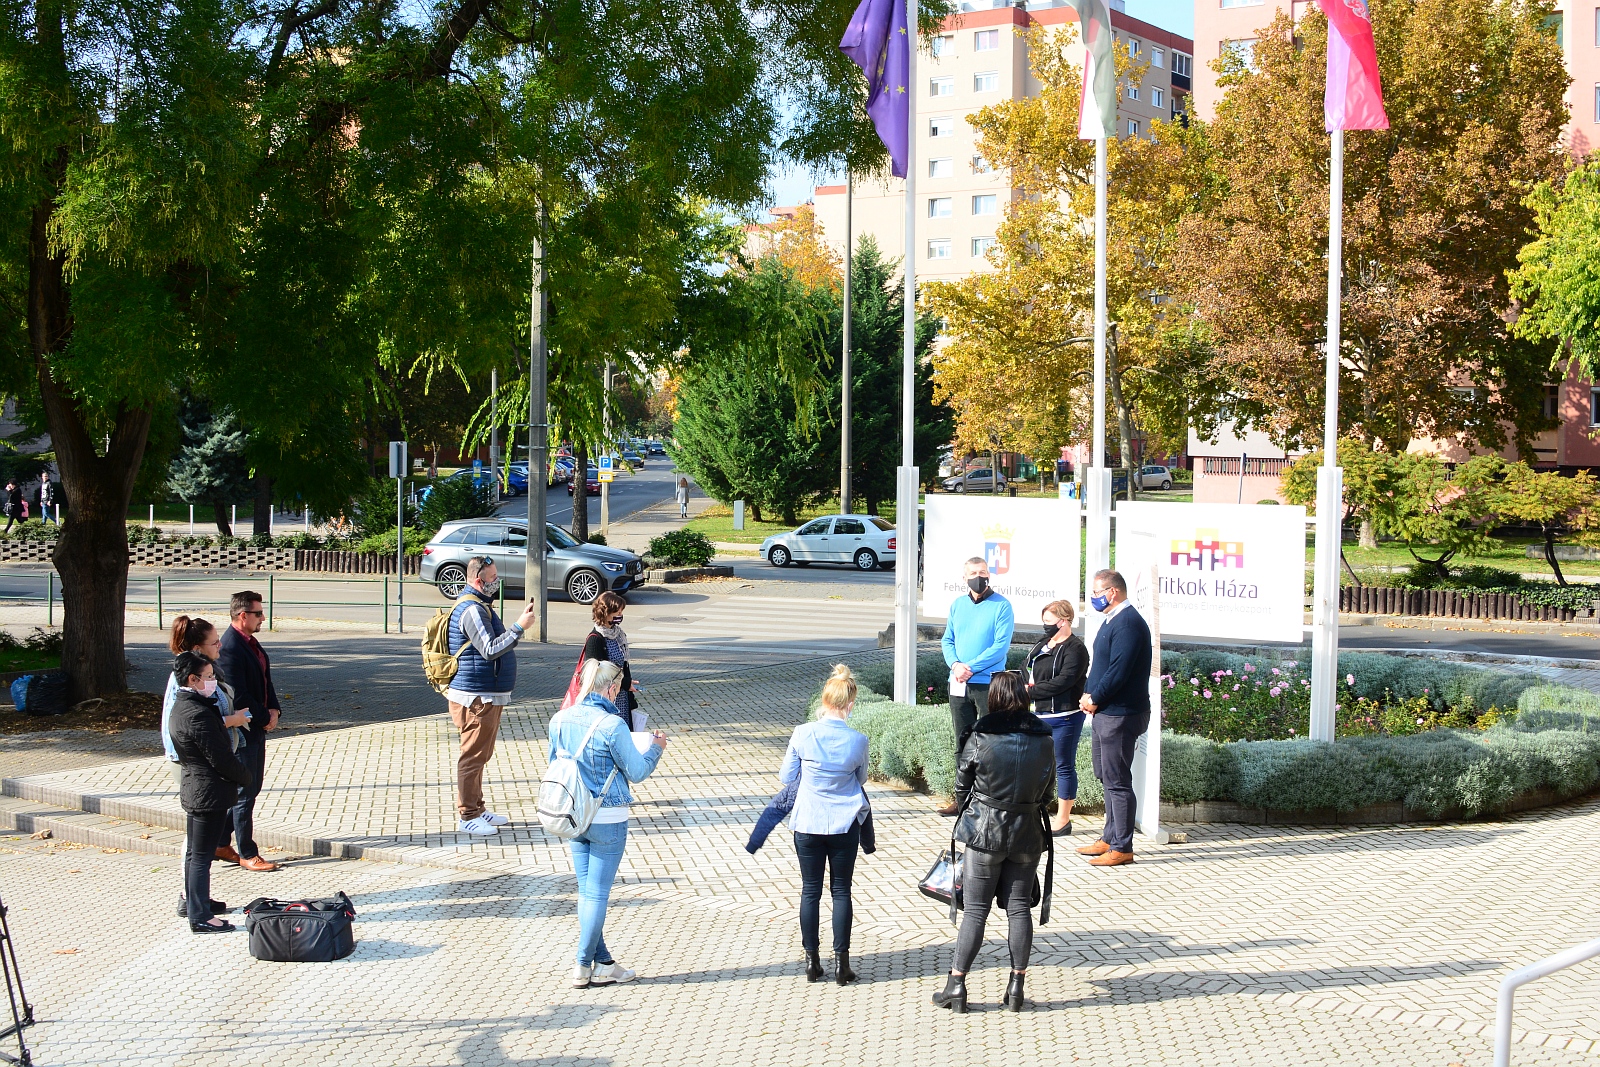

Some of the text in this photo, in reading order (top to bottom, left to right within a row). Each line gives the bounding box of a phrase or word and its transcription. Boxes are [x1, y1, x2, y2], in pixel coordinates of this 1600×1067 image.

[602, 459, 609, 467] P
[943, 583, 1056, 599] Fehér Civil Központ
[1158, 577, 1258, 598] Titkok Háza
[1158, 600, 1198, 611] ományos
